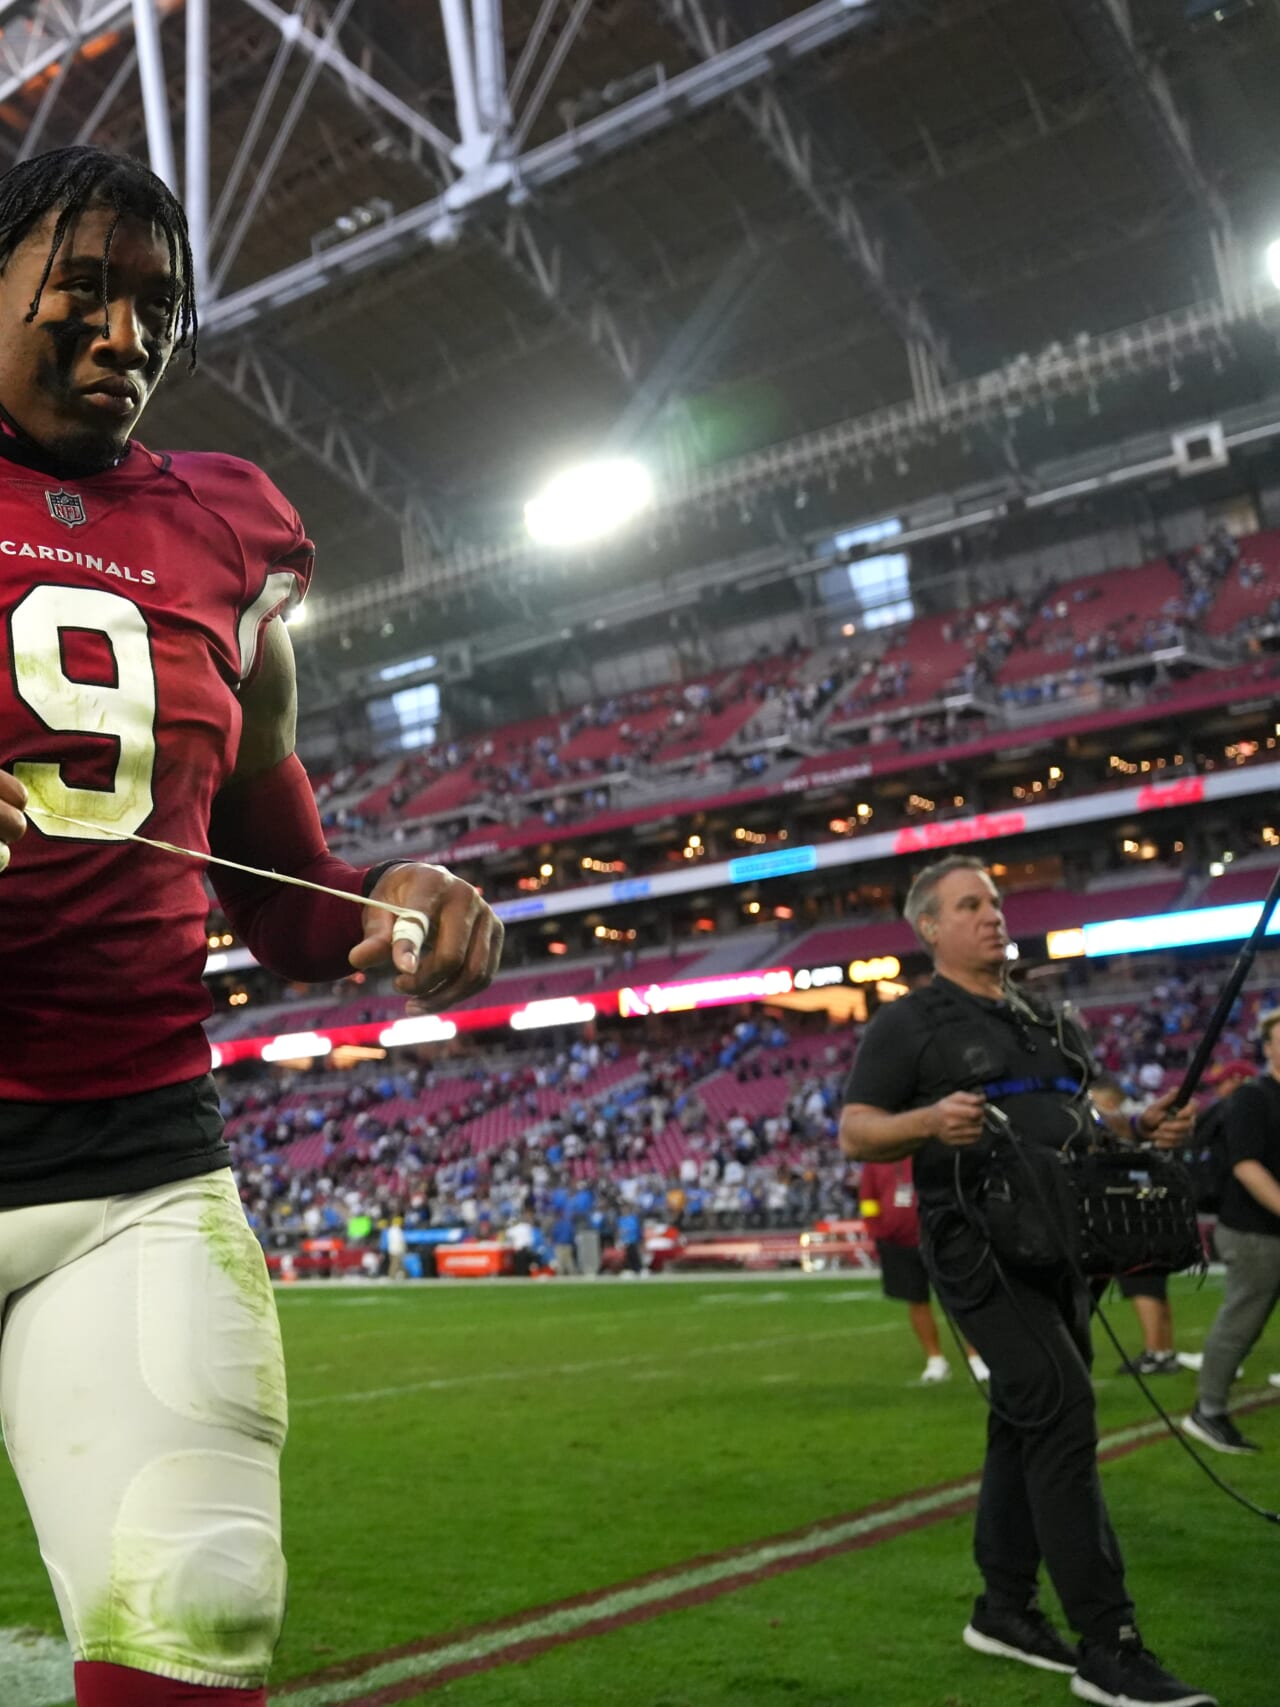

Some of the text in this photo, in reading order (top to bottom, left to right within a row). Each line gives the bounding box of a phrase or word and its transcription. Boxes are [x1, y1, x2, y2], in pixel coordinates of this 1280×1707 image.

[55, 503, 81, 520] NFL
[0, 540, 157, 585] CARDINALS
[9, 582, 157, 842] 9
